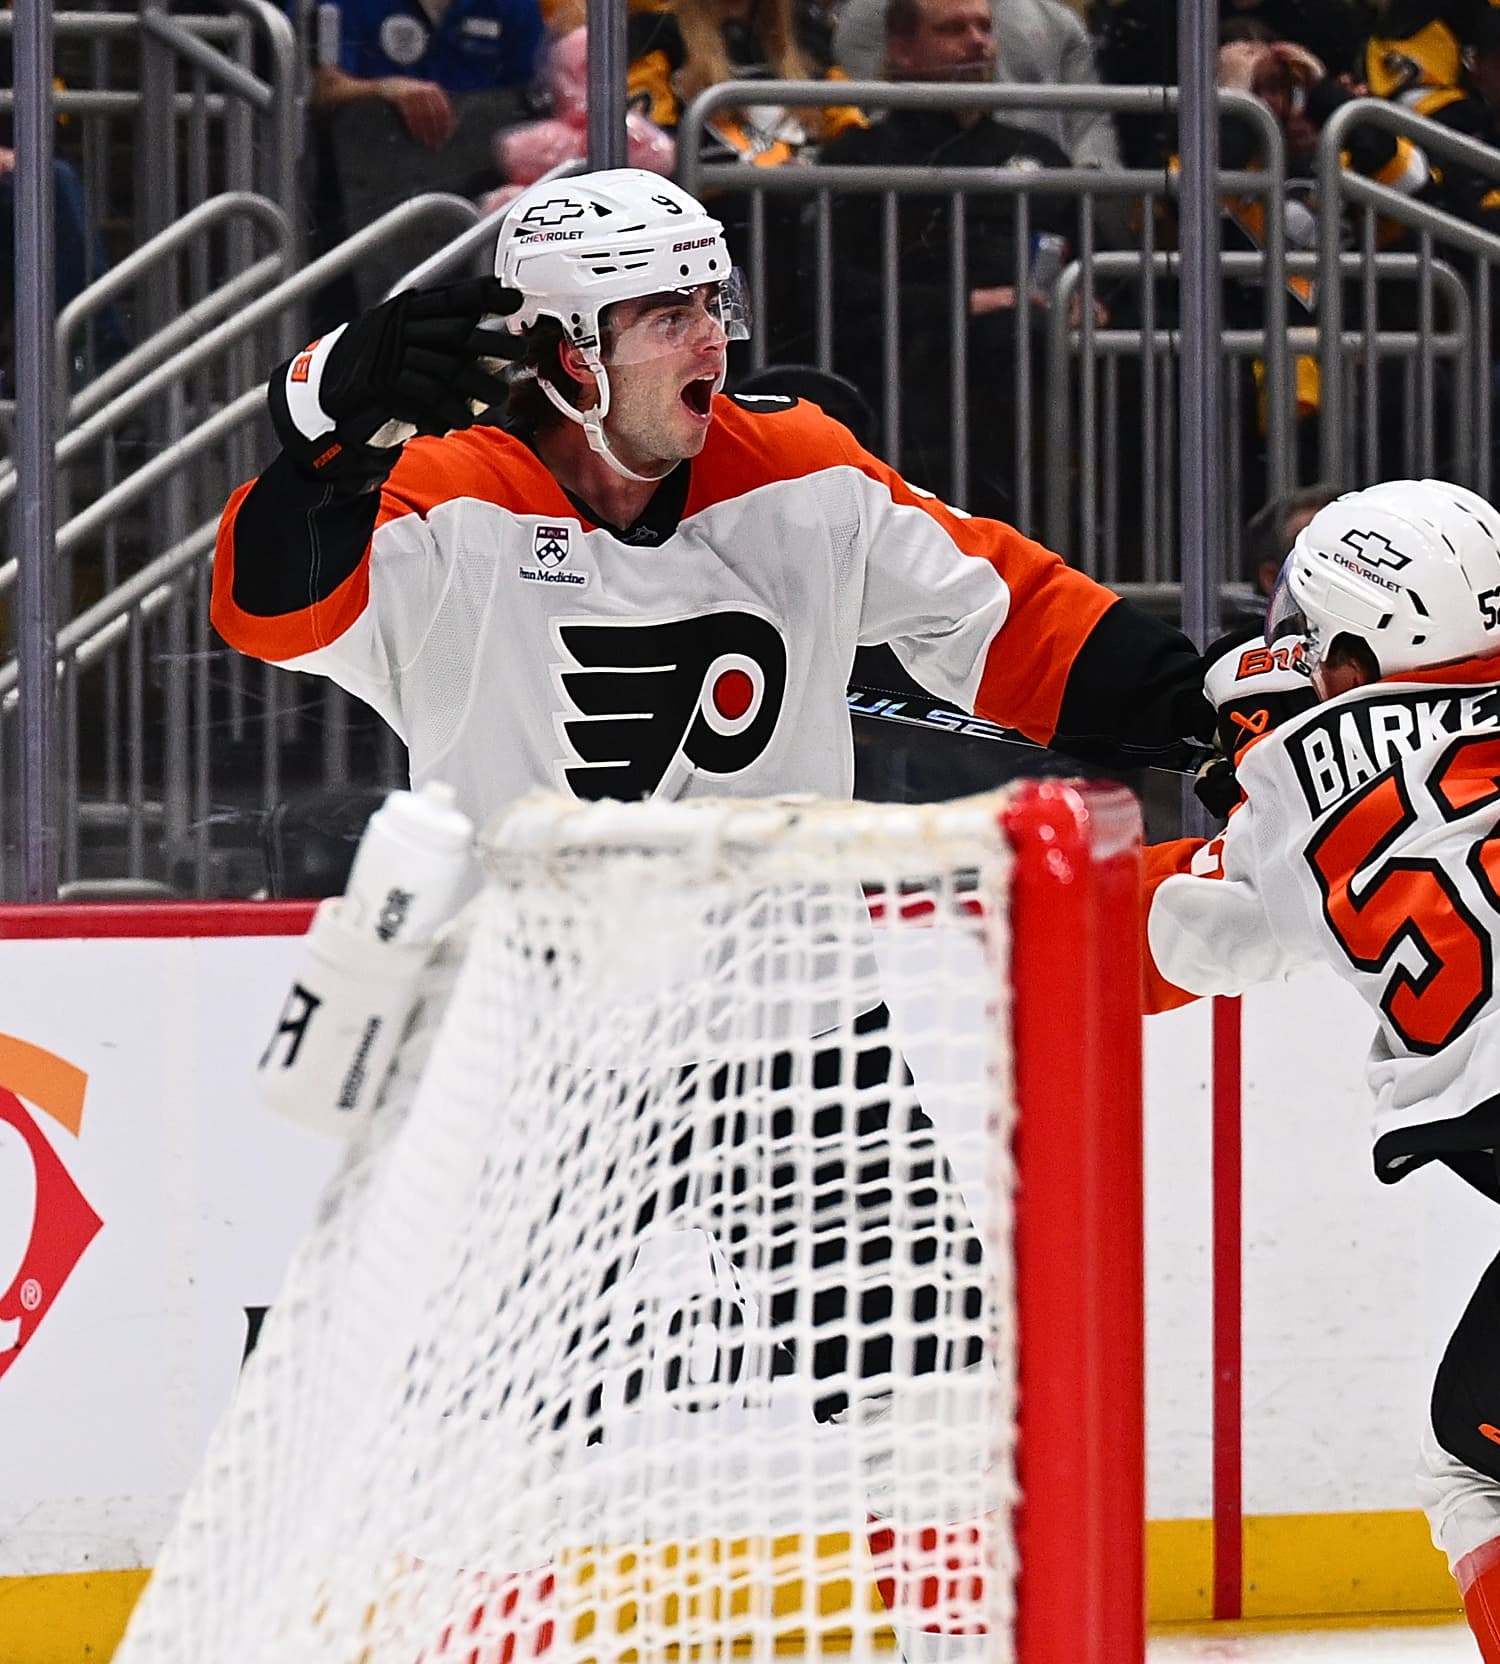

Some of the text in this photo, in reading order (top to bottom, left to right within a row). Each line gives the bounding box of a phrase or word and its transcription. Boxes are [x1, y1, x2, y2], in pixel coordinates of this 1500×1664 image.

[651, 195, 683, 215] 9
[519, 230, 585, 244] CHEVROLET
[672, 236, 717, 253] BAUER
[1332, 552, 1402, 594] CHEVROLET
